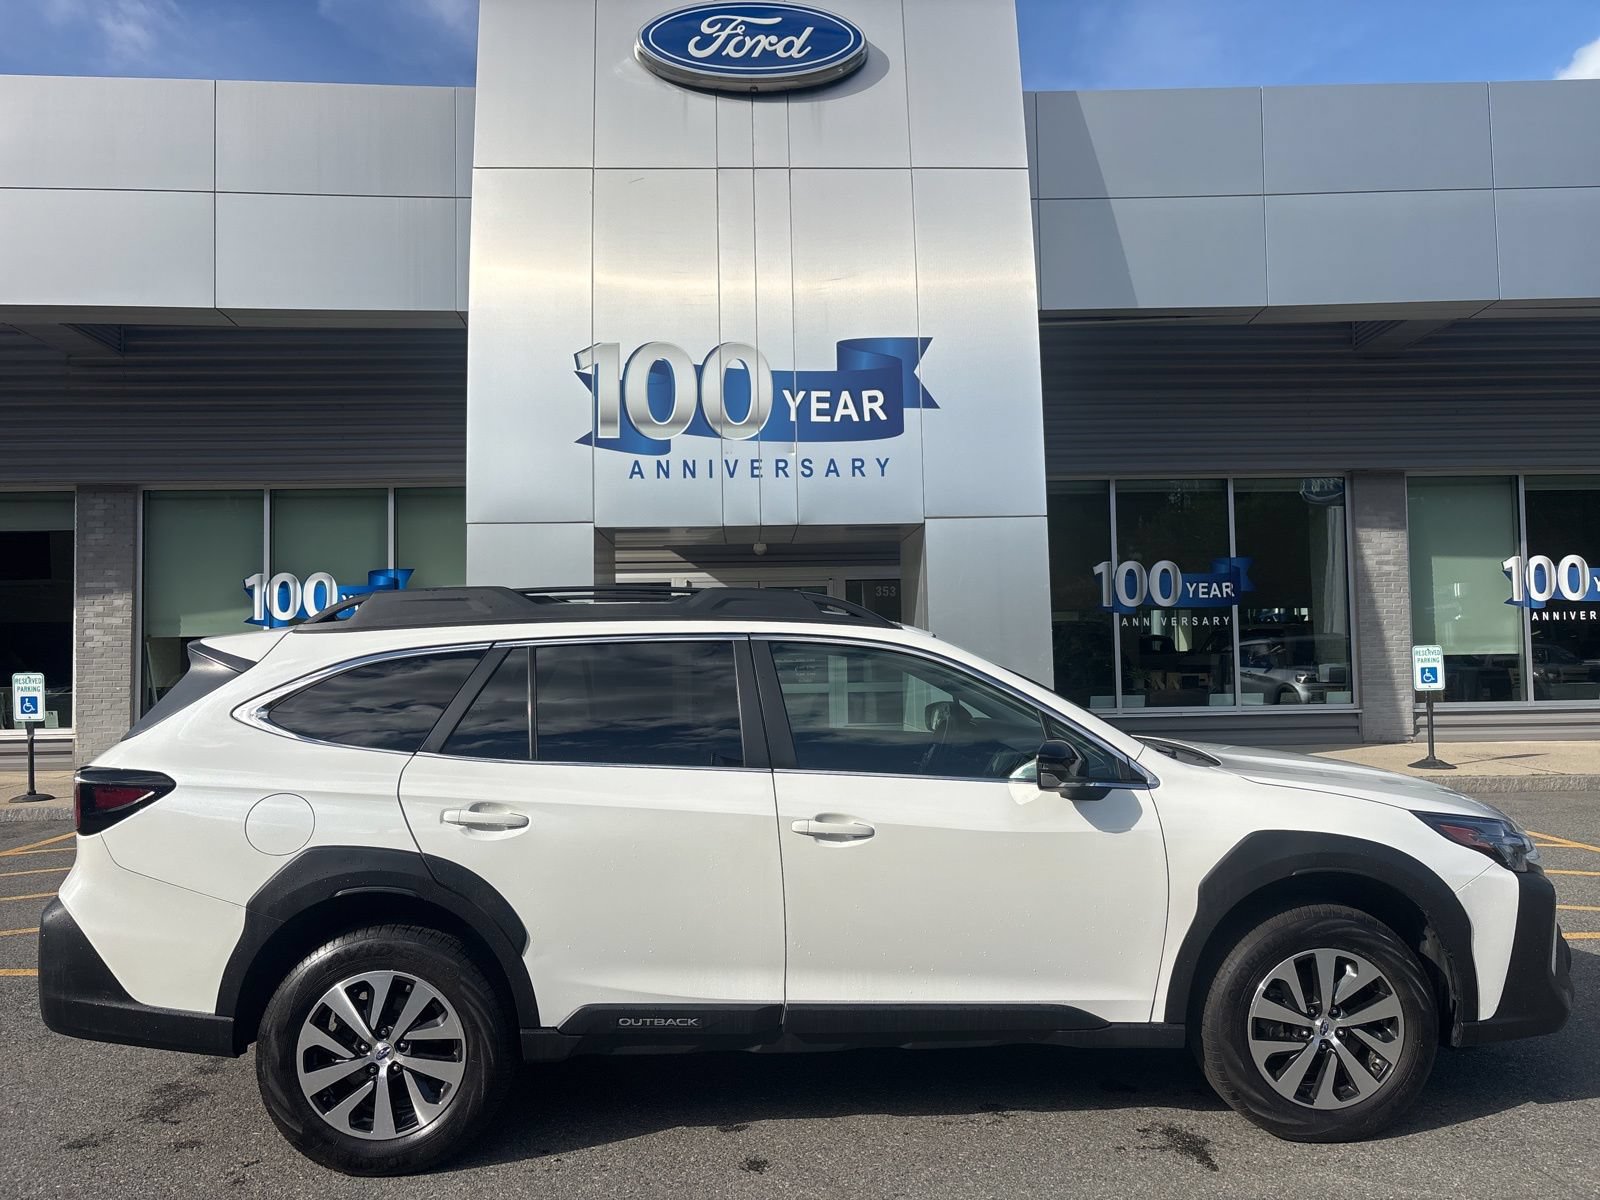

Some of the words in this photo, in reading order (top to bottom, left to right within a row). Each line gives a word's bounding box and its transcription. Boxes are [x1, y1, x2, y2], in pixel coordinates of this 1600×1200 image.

[687, 14, 815, 59] Ford
[574, 341, 773, 440] 100
[782, 389, 888, 422] YEAR
[629, 457, 890, 479] ANNIVERSARY
[1093, 560, 1182, 607] 100
[1186, 582, 1235, 598] YEAR
[1501, 554, 1590, 602] 100
[243, 571, 338, 621] 100
[875, 585, 897, 597] 353
[1121, 616, 1230, 626] ANNVERSARY
[1531, 611, 1597, 621] ANNIVER
[14, 677, 42, 685] RESERVED
[618, 1018, 699, 1026] OUTBACK
